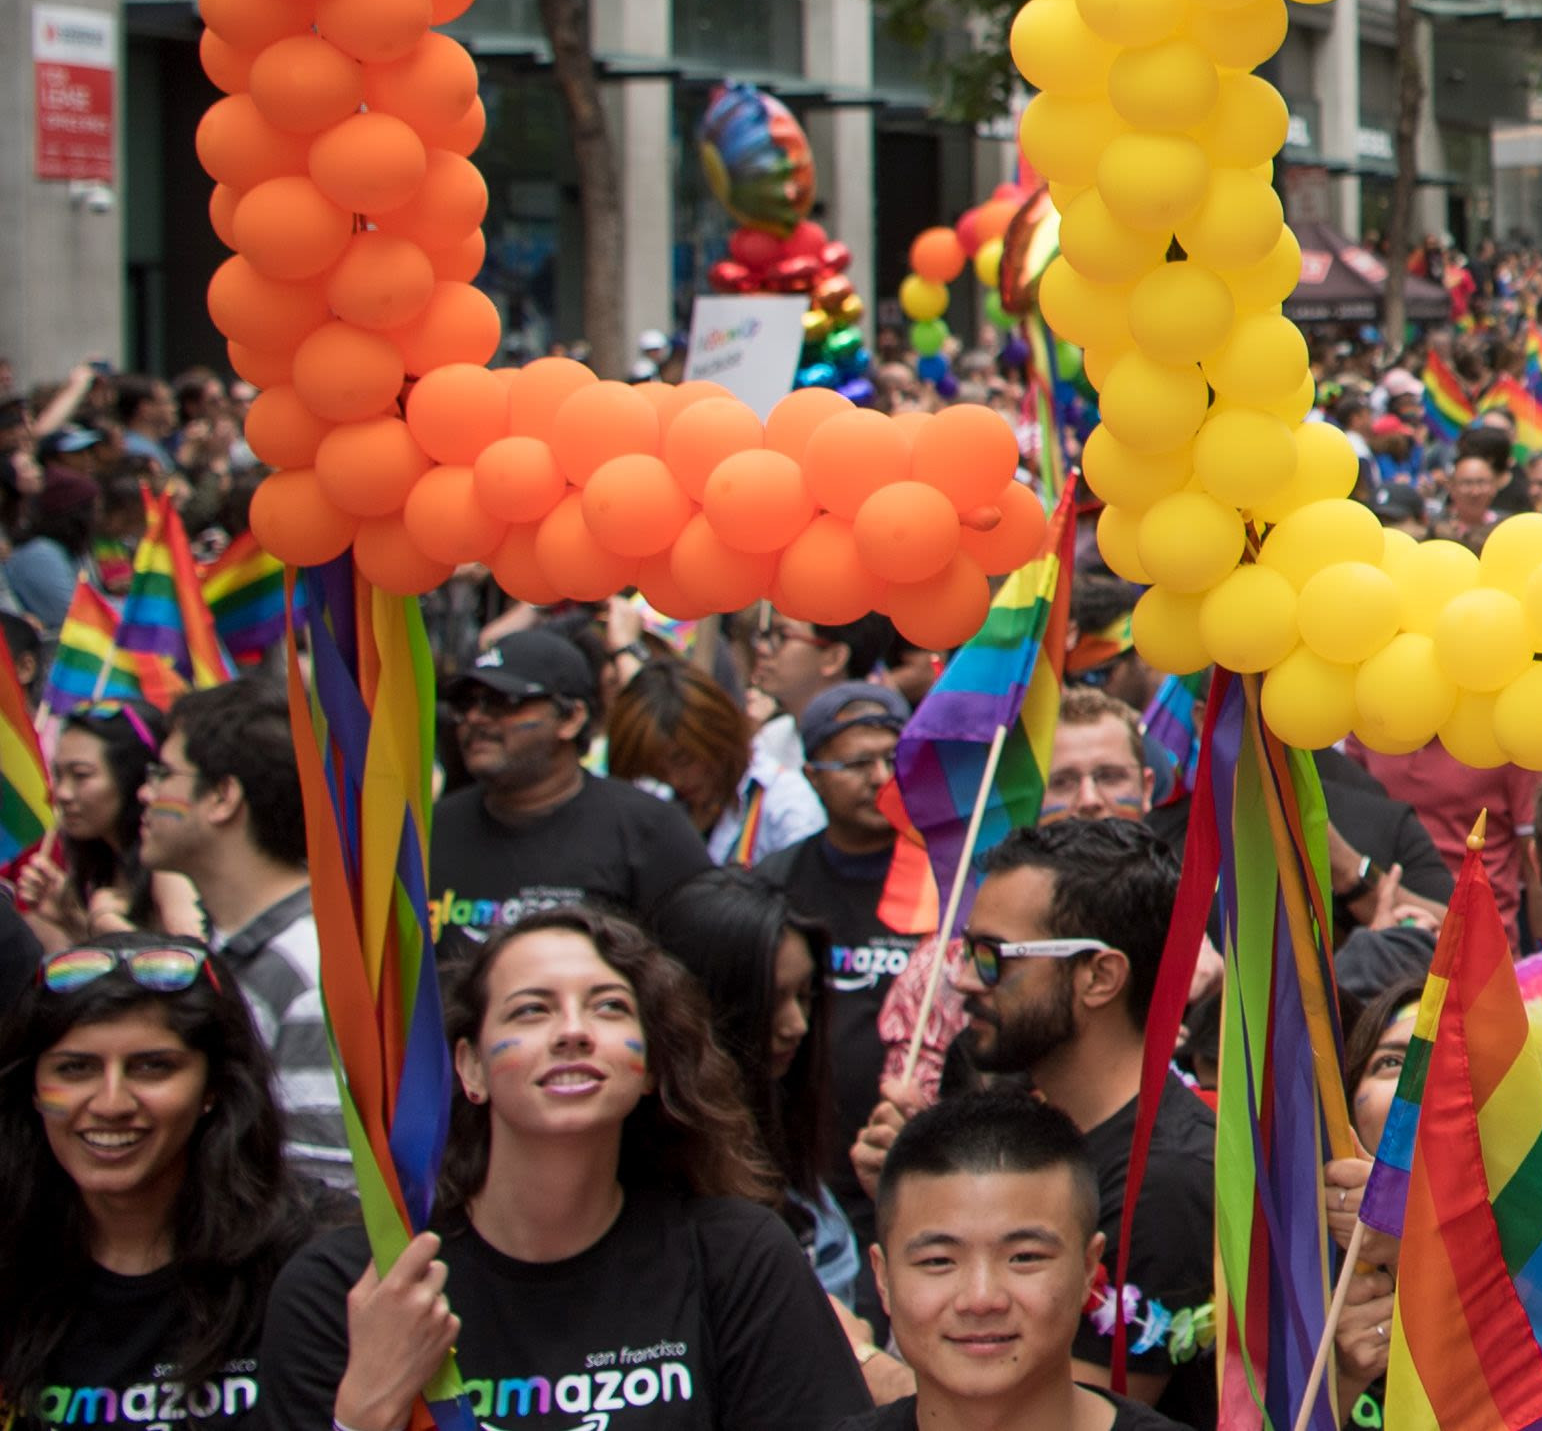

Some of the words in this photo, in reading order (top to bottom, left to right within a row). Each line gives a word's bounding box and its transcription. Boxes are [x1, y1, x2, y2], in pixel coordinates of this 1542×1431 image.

[585, 1351, 617, 1368] san
[620, 1339, 687, 1365] francisco
[40, 1376, 258, 1424] amazon
[462, 1362, 693, 1417] amazon
